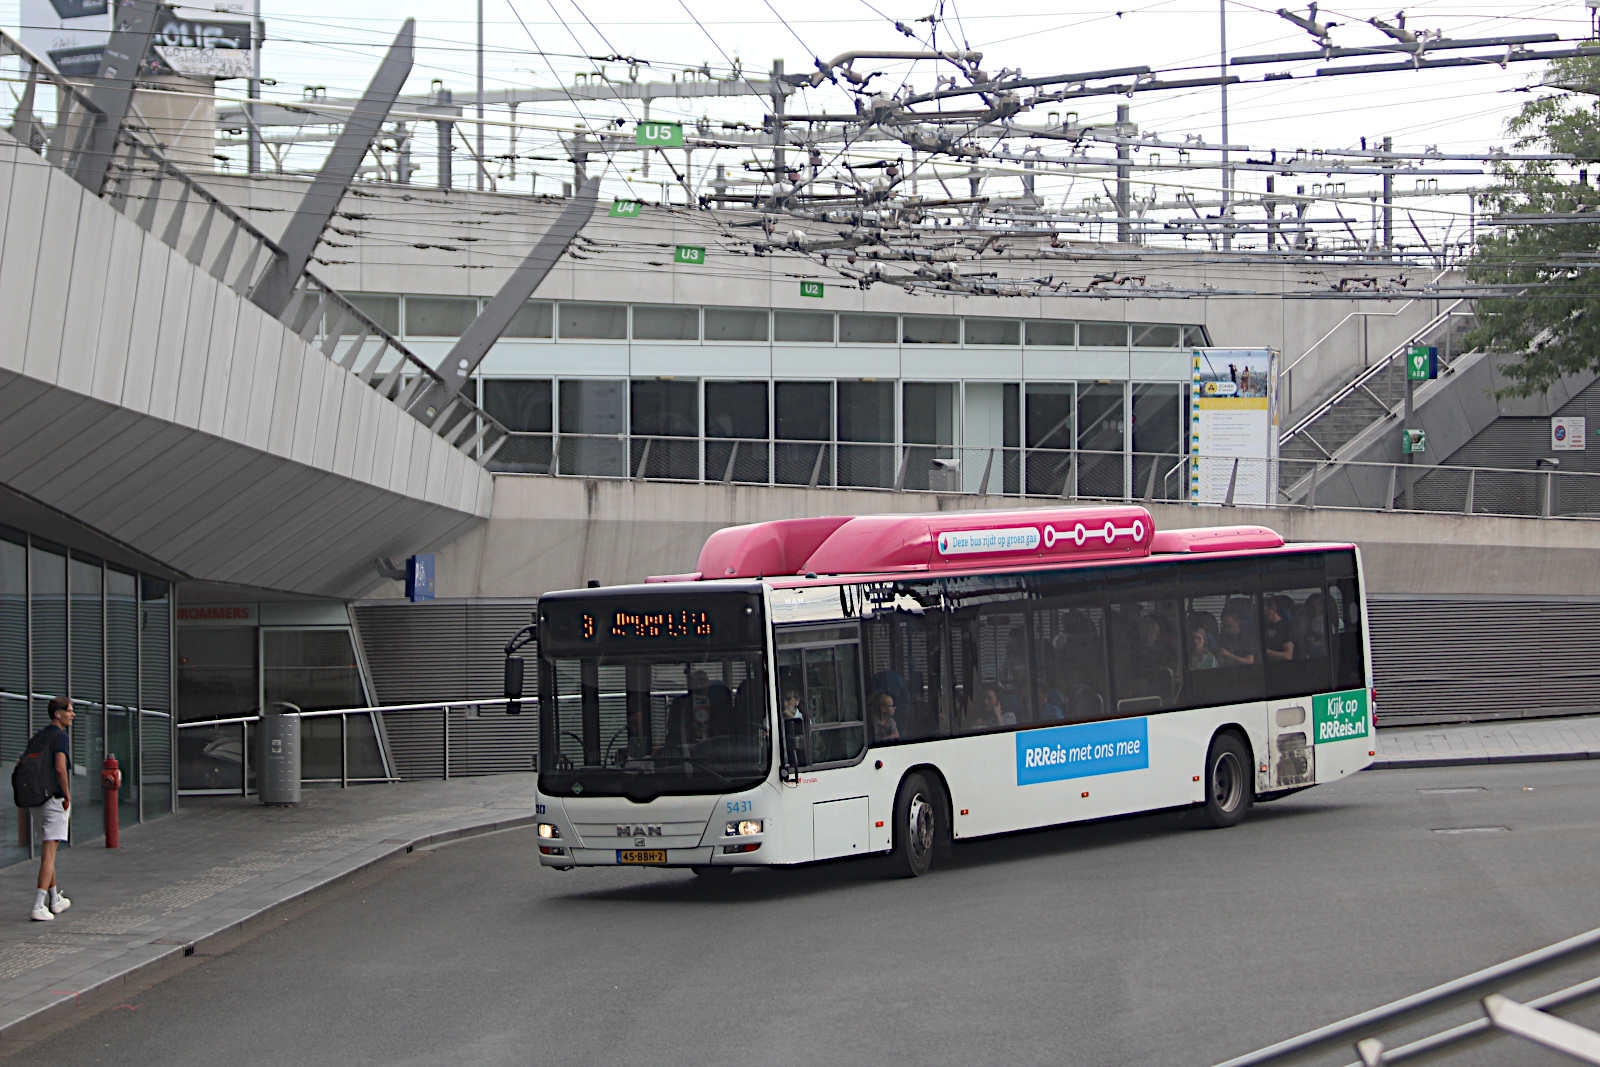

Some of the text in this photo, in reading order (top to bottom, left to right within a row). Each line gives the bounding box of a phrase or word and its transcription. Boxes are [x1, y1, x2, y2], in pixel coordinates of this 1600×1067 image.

[645, 125, 672, 140] U5
[617, 201, 635, 213] U4
[681, 248, 698, 260] U3
[805, 284, 819, 294] U2
[1412, 370, 1426, 378] AED
[952, 534, 1037, 549] Deze bus rijdt op groen gas
[1327, 696, 1359, 719] Kijk op
[1319, 716, 1366, 740] RRReis.nl
[1025, 739, 1141, 768] RRReis met ons mee
[726, 800, 752, 814] 5431
[616, 824, 662, 838] MAN
[622, 852, 664, 862] 45-BBH-2
